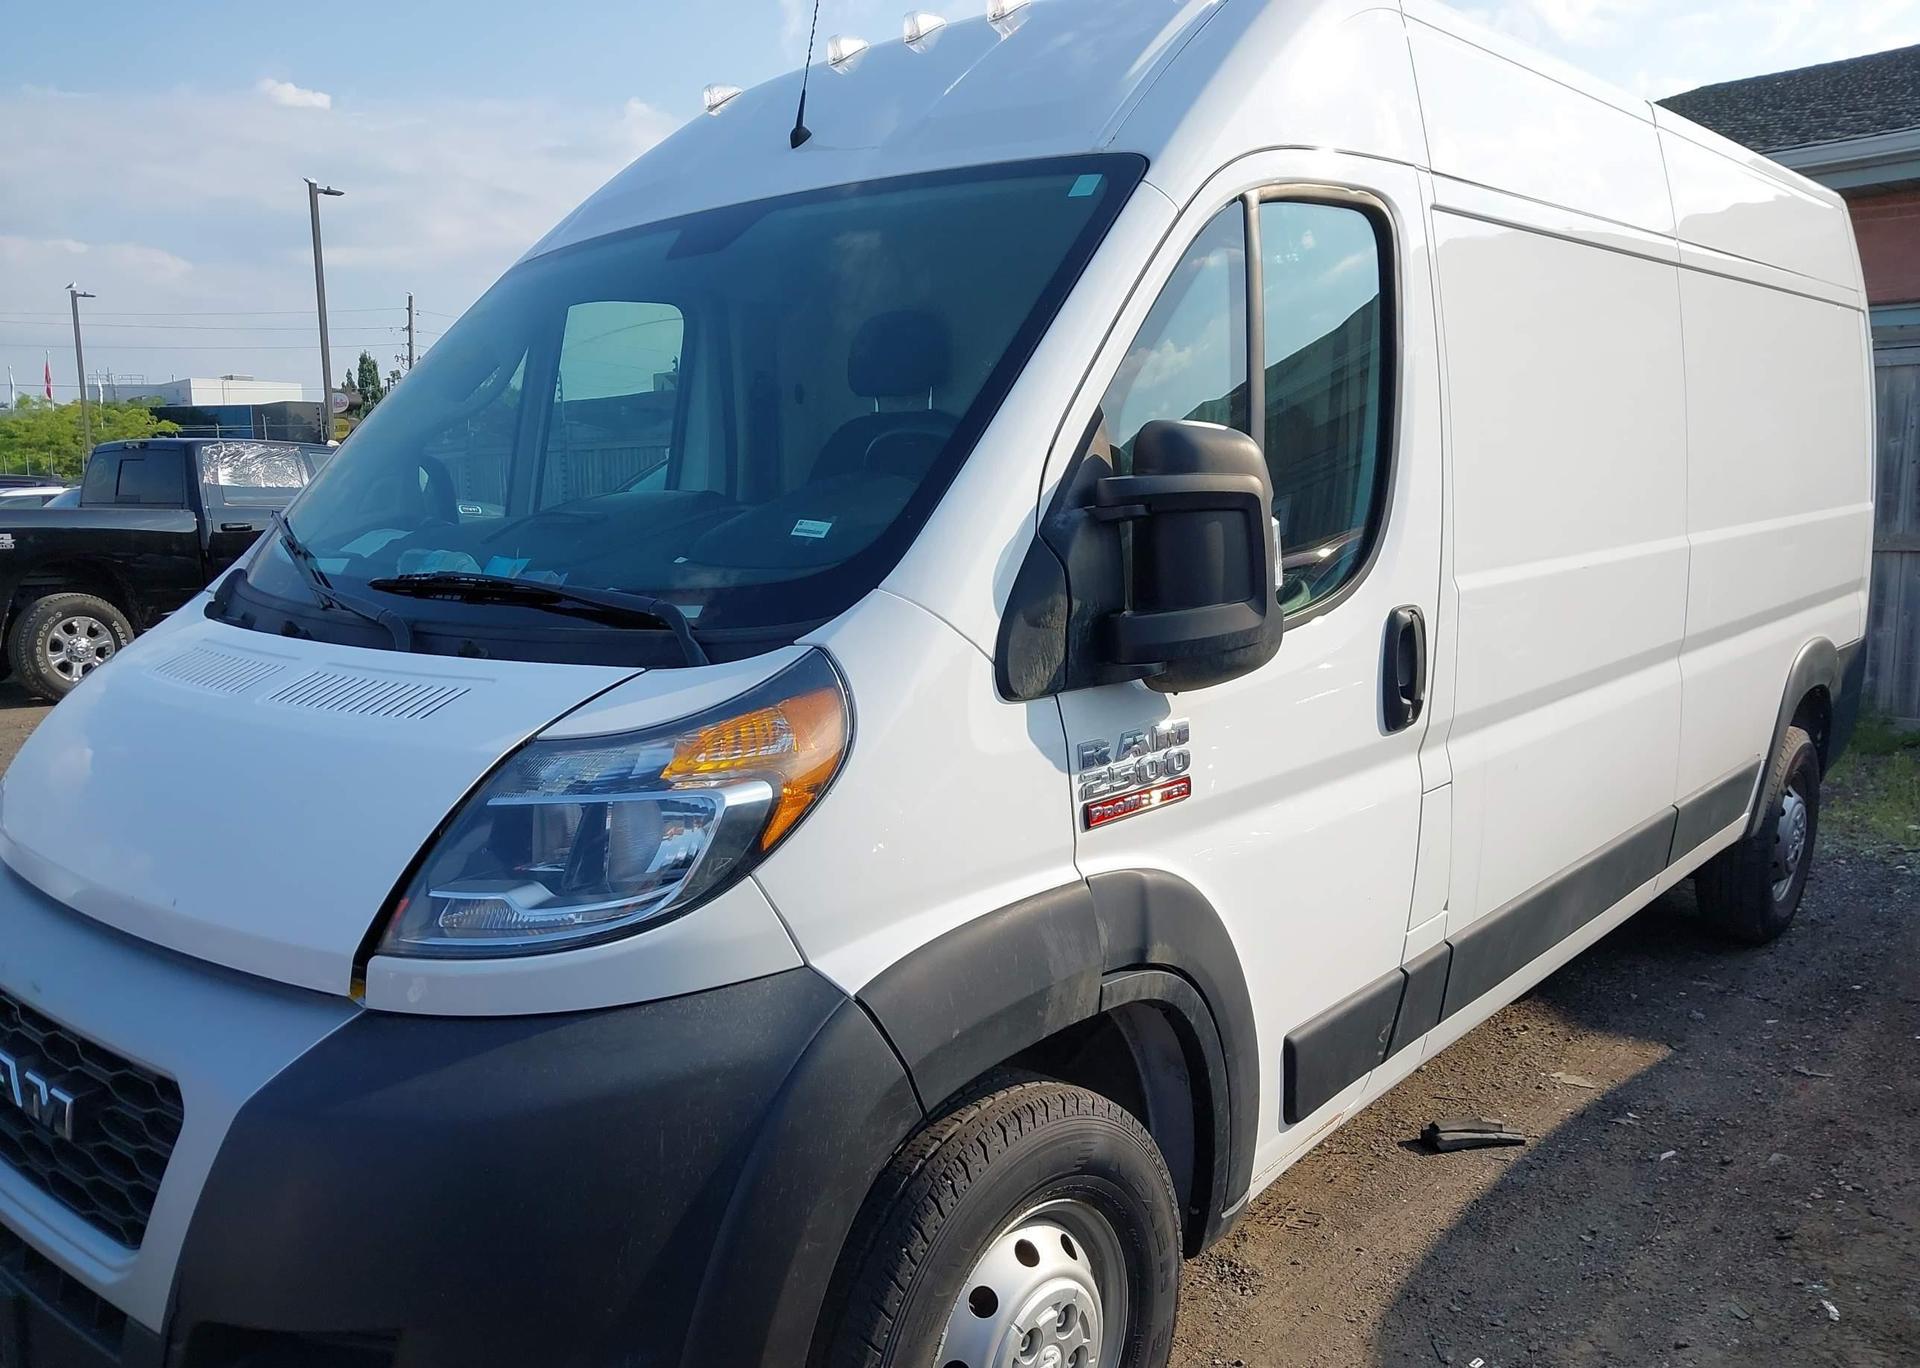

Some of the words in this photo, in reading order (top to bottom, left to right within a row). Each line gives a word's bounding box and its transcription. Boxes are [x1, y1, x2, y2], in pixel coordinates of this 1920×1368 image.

[1077, 719, 1190, 771] RAM
[1078, 746, 1191, 803] 2500
[1089, 783, 1189, 821] PROMATER
